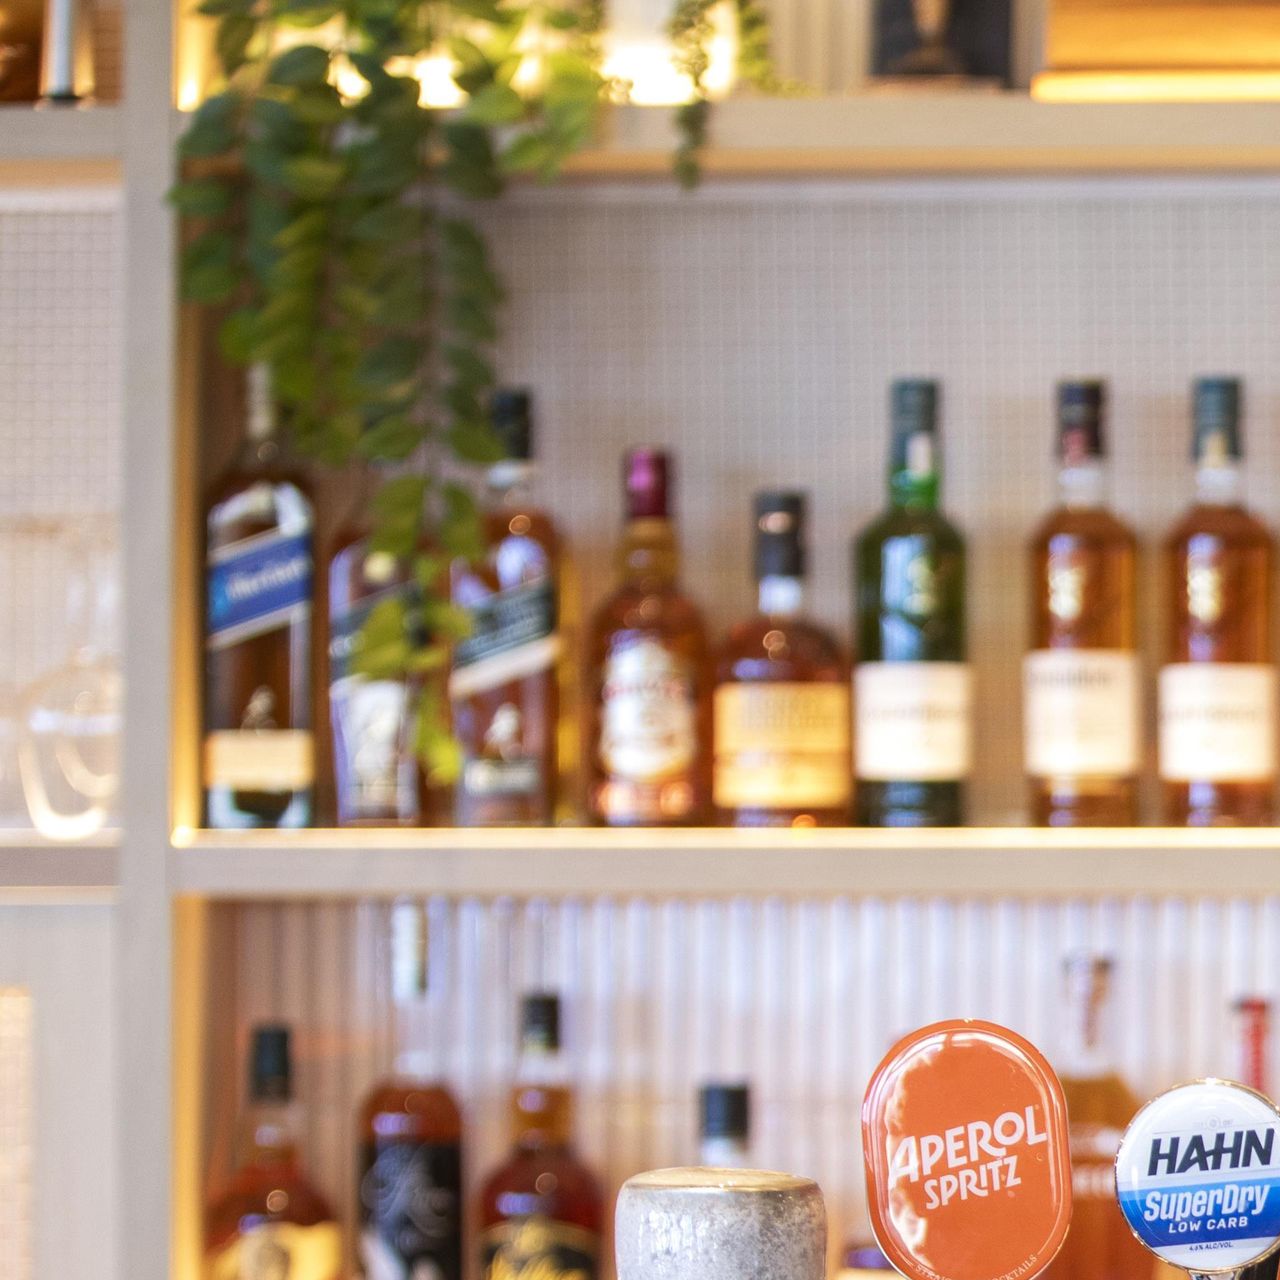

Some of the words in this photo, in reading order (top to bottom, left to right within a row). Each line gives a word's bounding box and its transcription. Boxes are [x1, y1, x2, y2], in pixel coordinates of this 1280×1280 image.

[891, 1105, 1048, 1183] APEROL
[1148, 1128, 1274, 1176] HAHN
[924, 1155, 1021, 1210] SPRITZ
[1144, 1184, 1271, 1221] SuperDry
[1169, 1221, 1201, 1233] LOW
[1207, 1216, 1248, 1229] CARB
